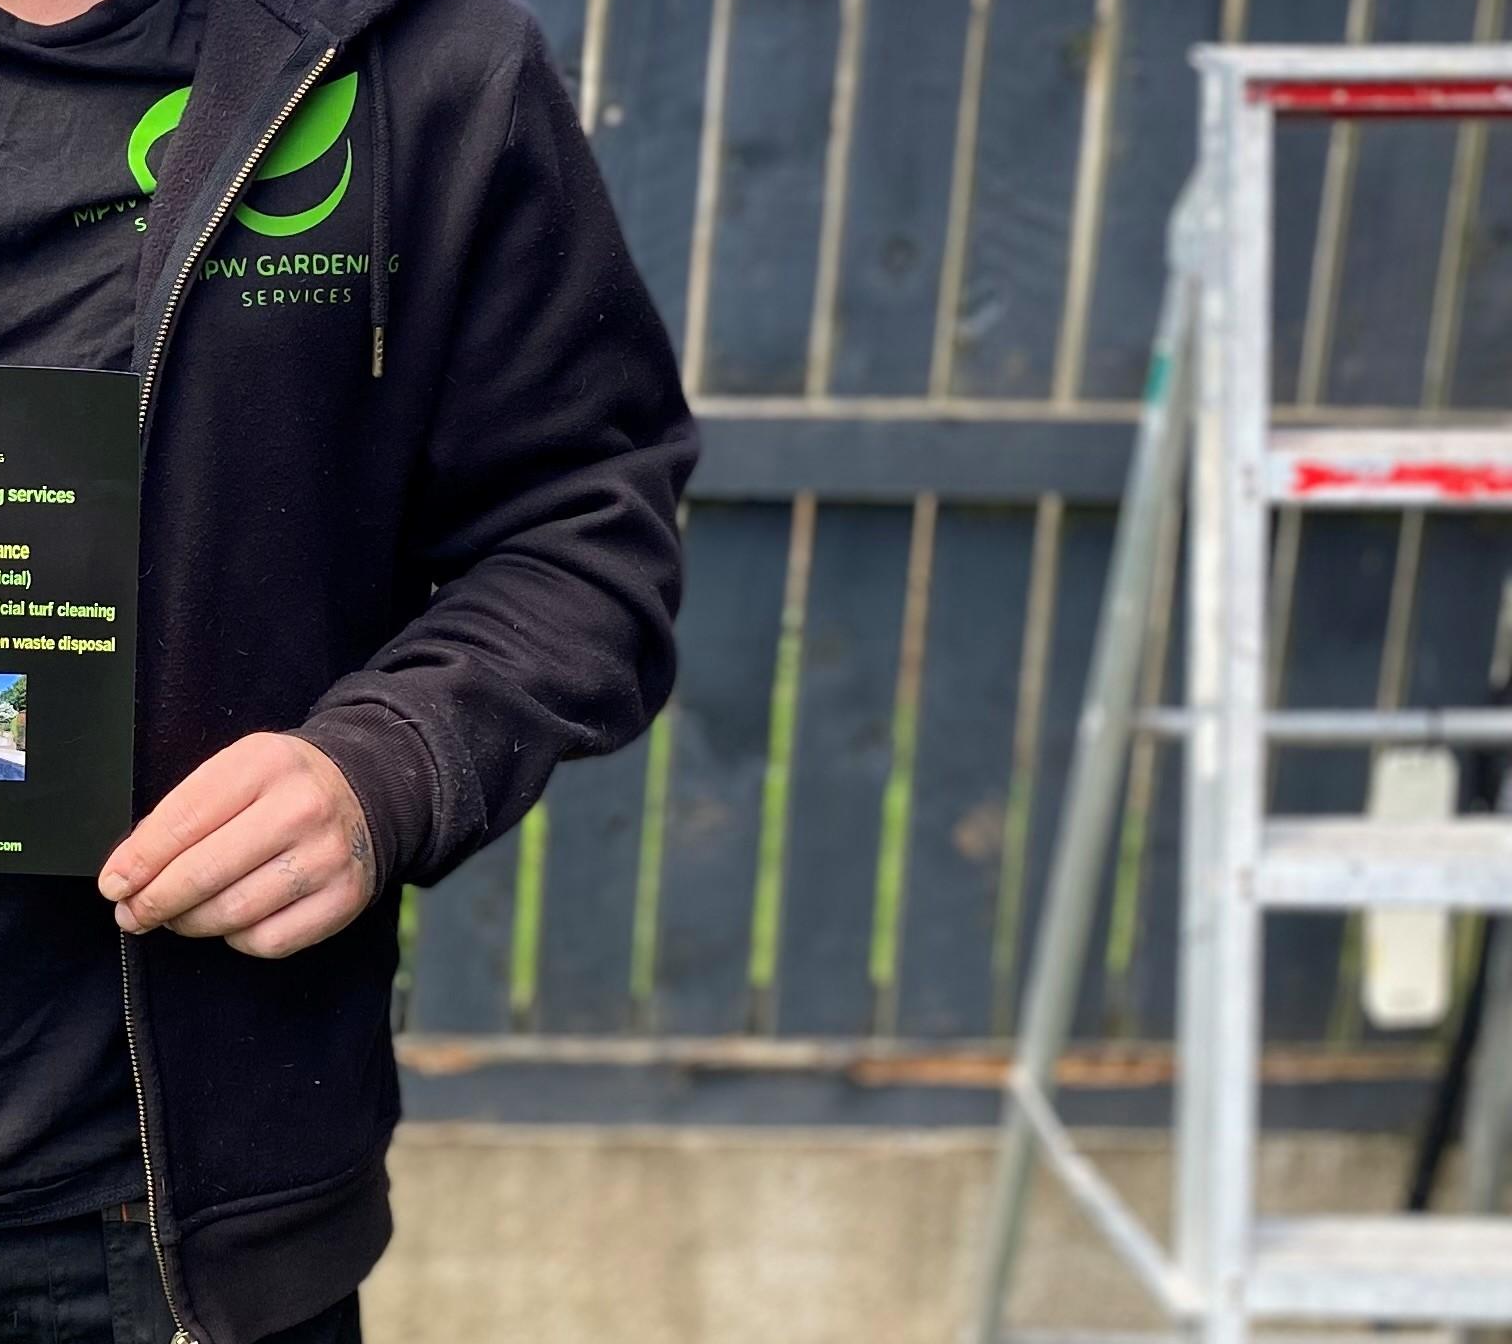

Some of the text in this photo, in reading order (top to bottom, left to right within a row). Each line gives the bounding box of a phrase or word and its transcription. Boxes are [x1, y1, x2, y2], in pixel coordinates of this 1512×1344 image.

[198, 253, 399, 282] PW GARDENIG
[241, 288, 352, 307] SERVICES
[8, 486, 75, 503] services
[29, 602, 54, 616] turf
[57, 602, 115, 621] cleaning
[12, 636, 55, 649] waste
[58, 636, 115, 654] disposal
